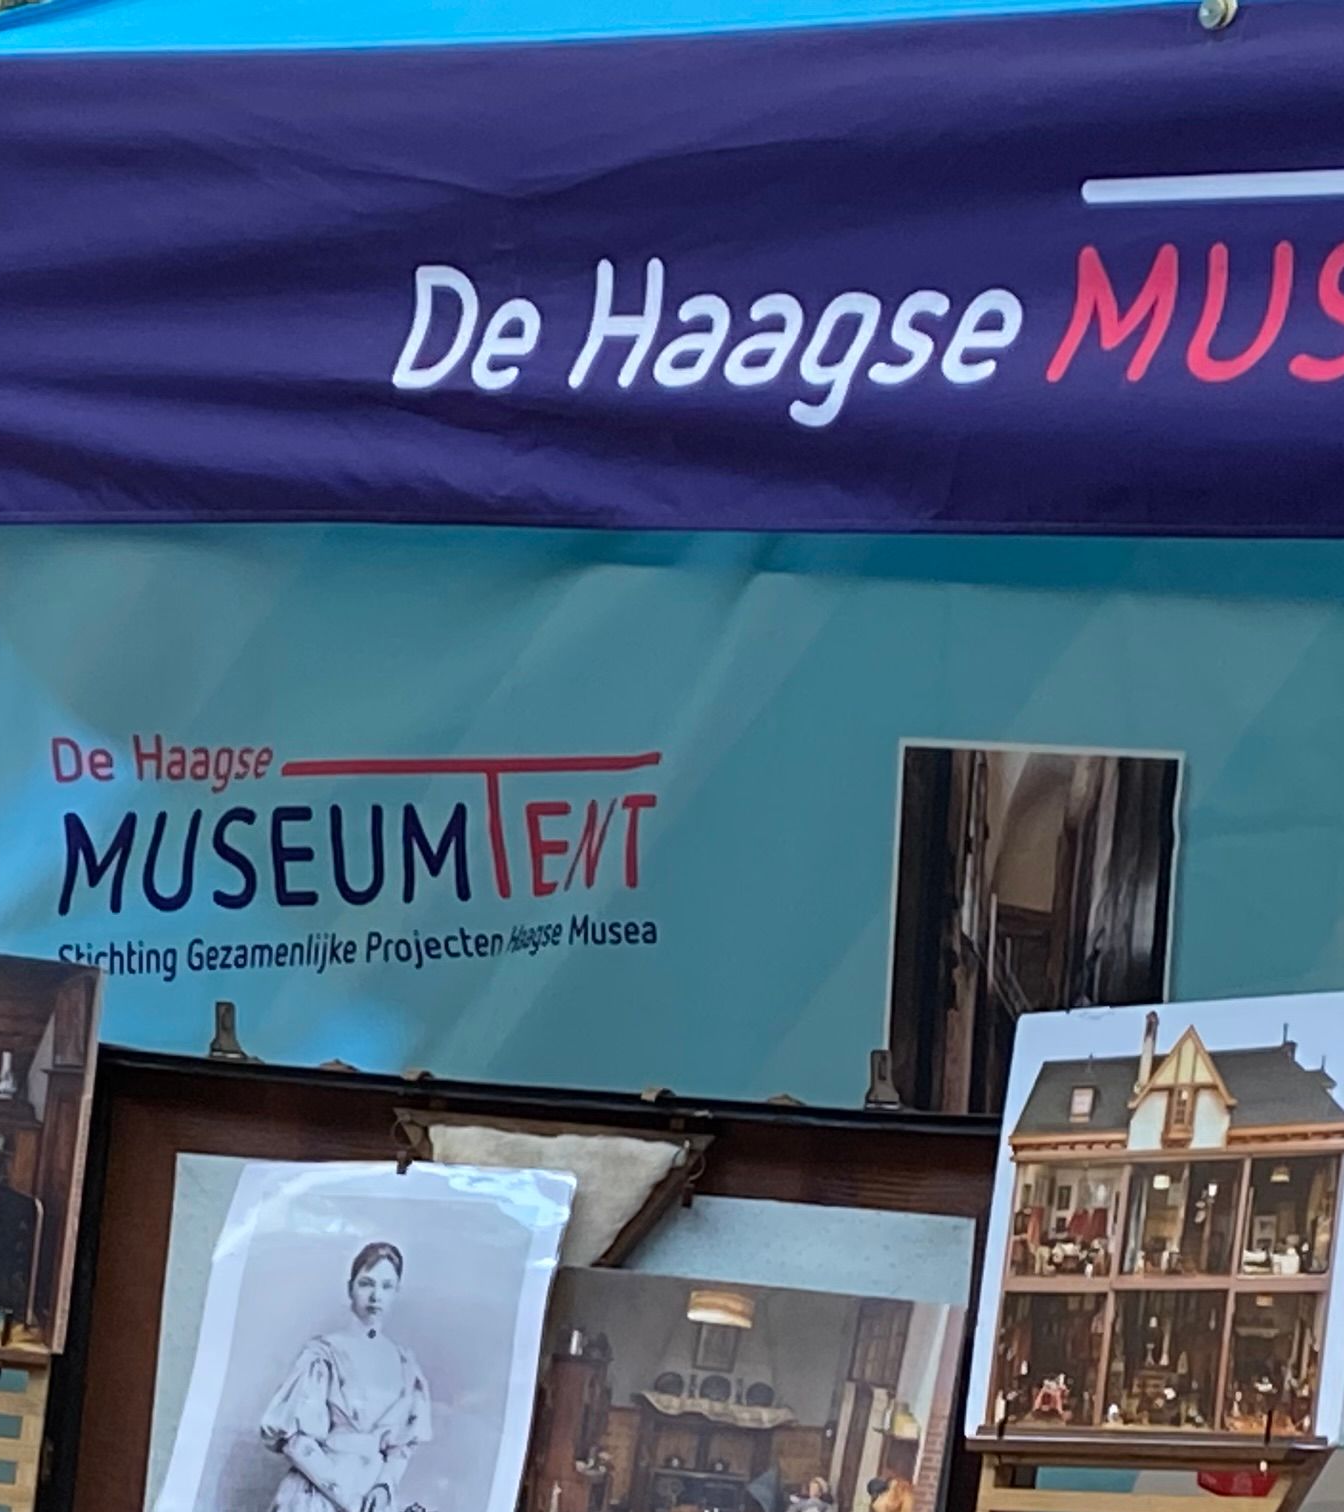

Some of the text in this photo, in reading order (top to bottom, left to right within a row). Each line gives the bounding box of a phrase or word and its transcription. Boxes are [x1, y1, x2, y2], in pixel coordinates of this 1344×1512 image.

[393, 264, 541, 390] De
[568, 257, 1024, 427] Haagse
[52, 734, 274, 793] De Haagse
[58, 914, 658, 982] Stichting Gezamenlijke Projecten Haagse Musea
